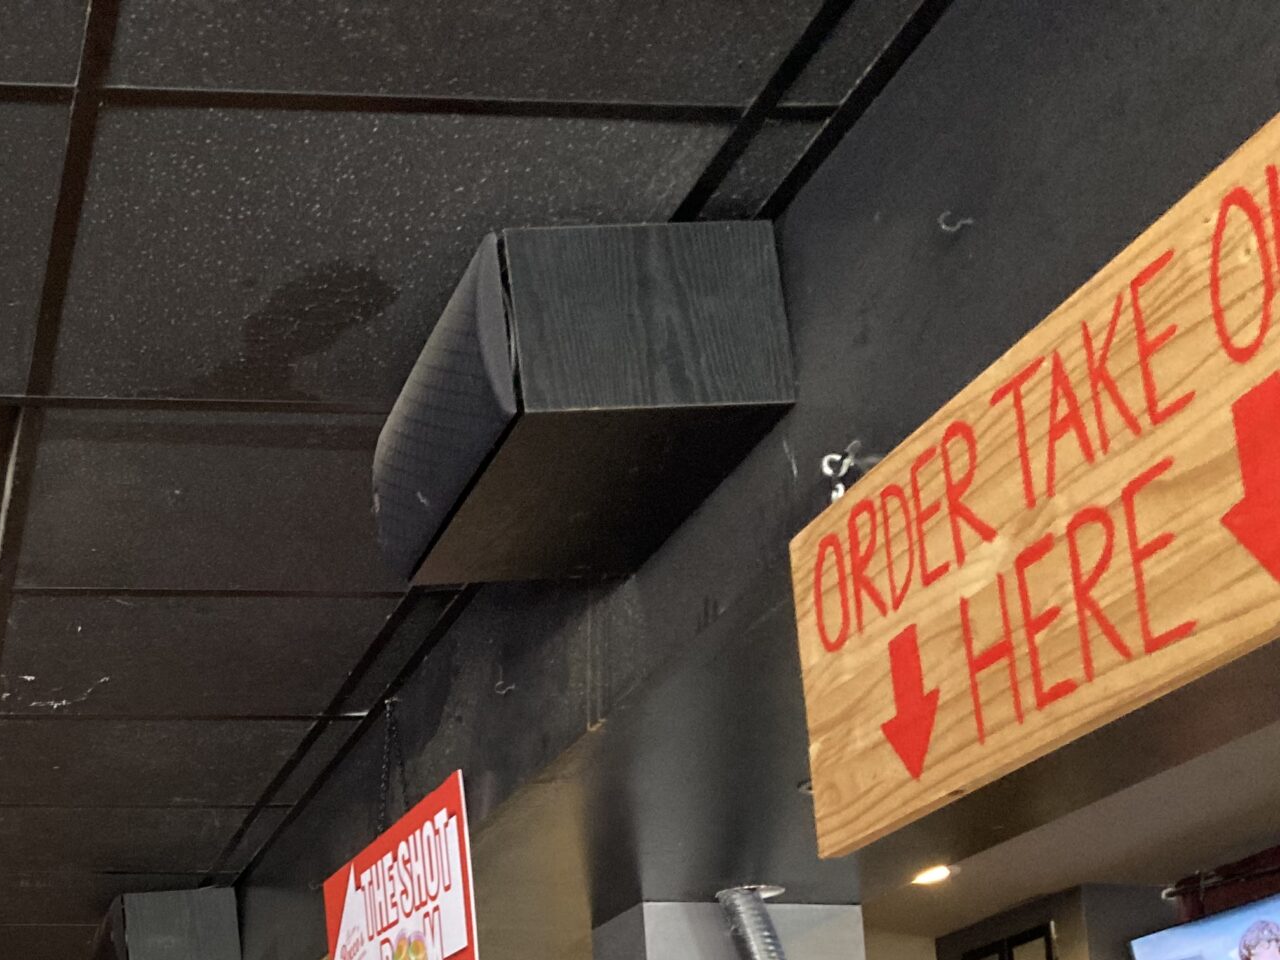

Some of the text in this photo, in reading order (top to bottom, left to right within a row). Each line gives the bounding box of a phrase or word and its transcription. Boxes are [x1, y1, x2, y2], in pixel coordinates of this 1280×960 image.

[814, 164, 1280, 653] ORDER TAKE O
[960, 457, 1197, 744] HERE
[360, 807, 454, 941] THE SHOT
